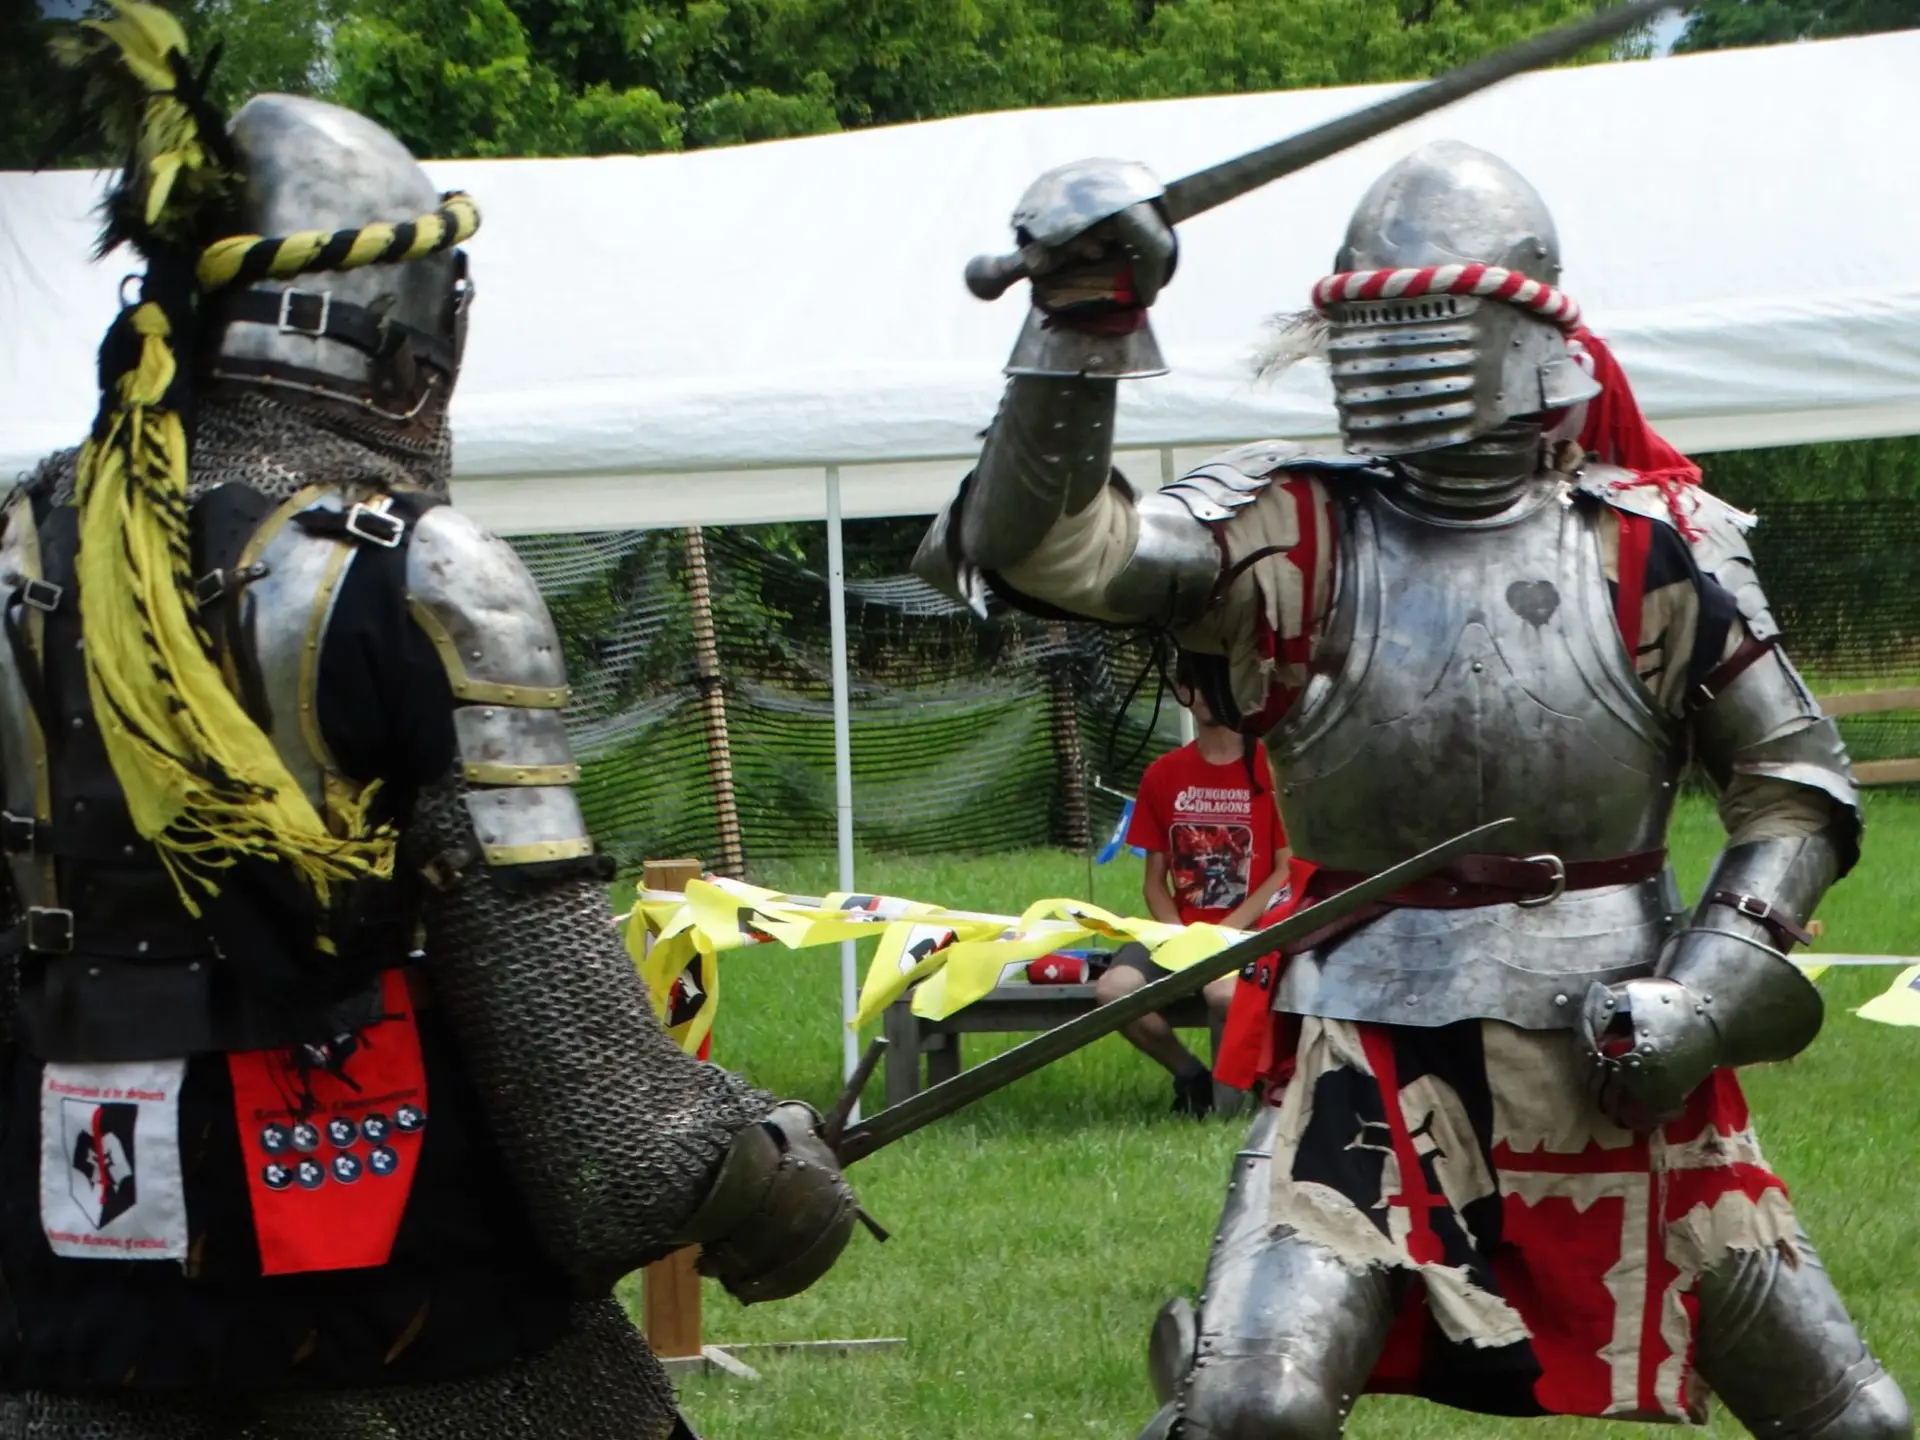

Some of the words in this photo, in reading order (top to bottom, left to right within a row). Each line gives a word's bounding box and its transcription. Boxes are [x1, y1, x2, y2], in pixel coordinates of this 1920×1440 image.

[1174, 790, 1194, 811] &
[1194, 799, 1251, 814] DRAGONS
[1187, 786, 1250, 801] DUNGEONS
